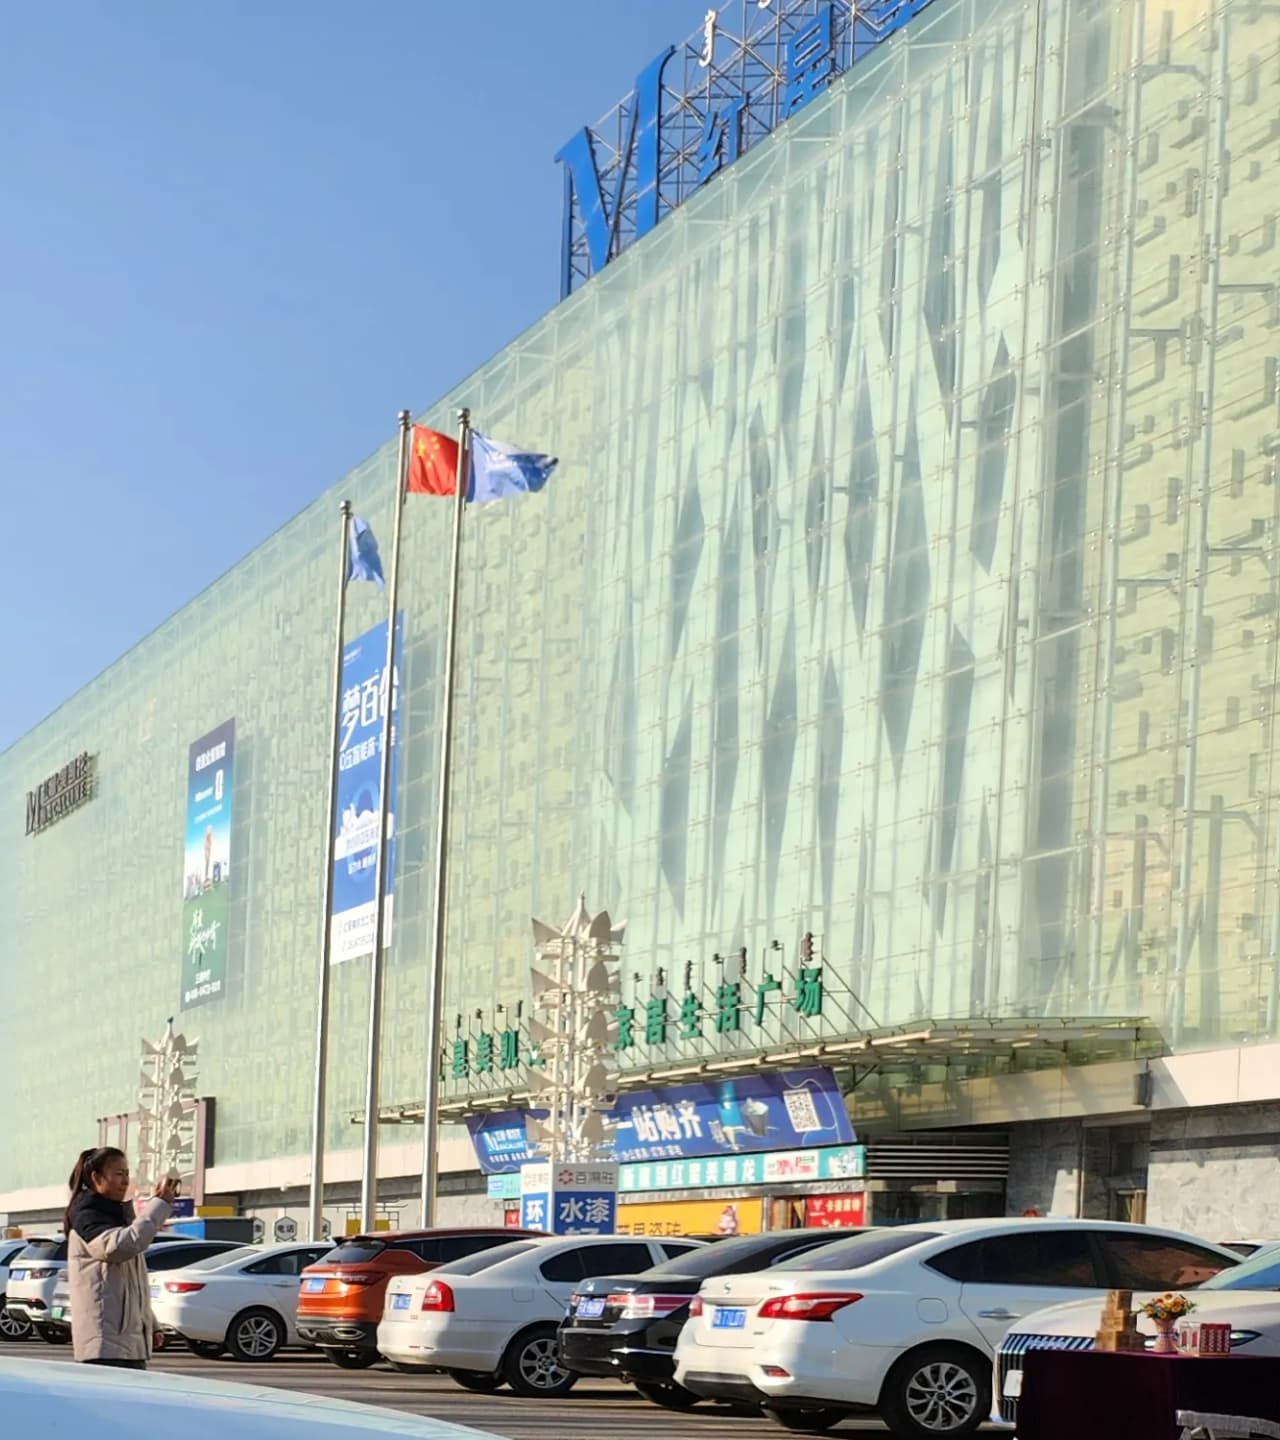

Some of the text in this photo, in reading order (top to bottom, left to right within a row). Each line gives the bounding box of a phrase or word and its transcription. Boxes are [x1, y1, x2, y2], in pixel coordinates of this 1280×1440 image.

[612, 968, 822, 1052] 家居生活广场
[559, 1198, 609, 1224] 水漆
